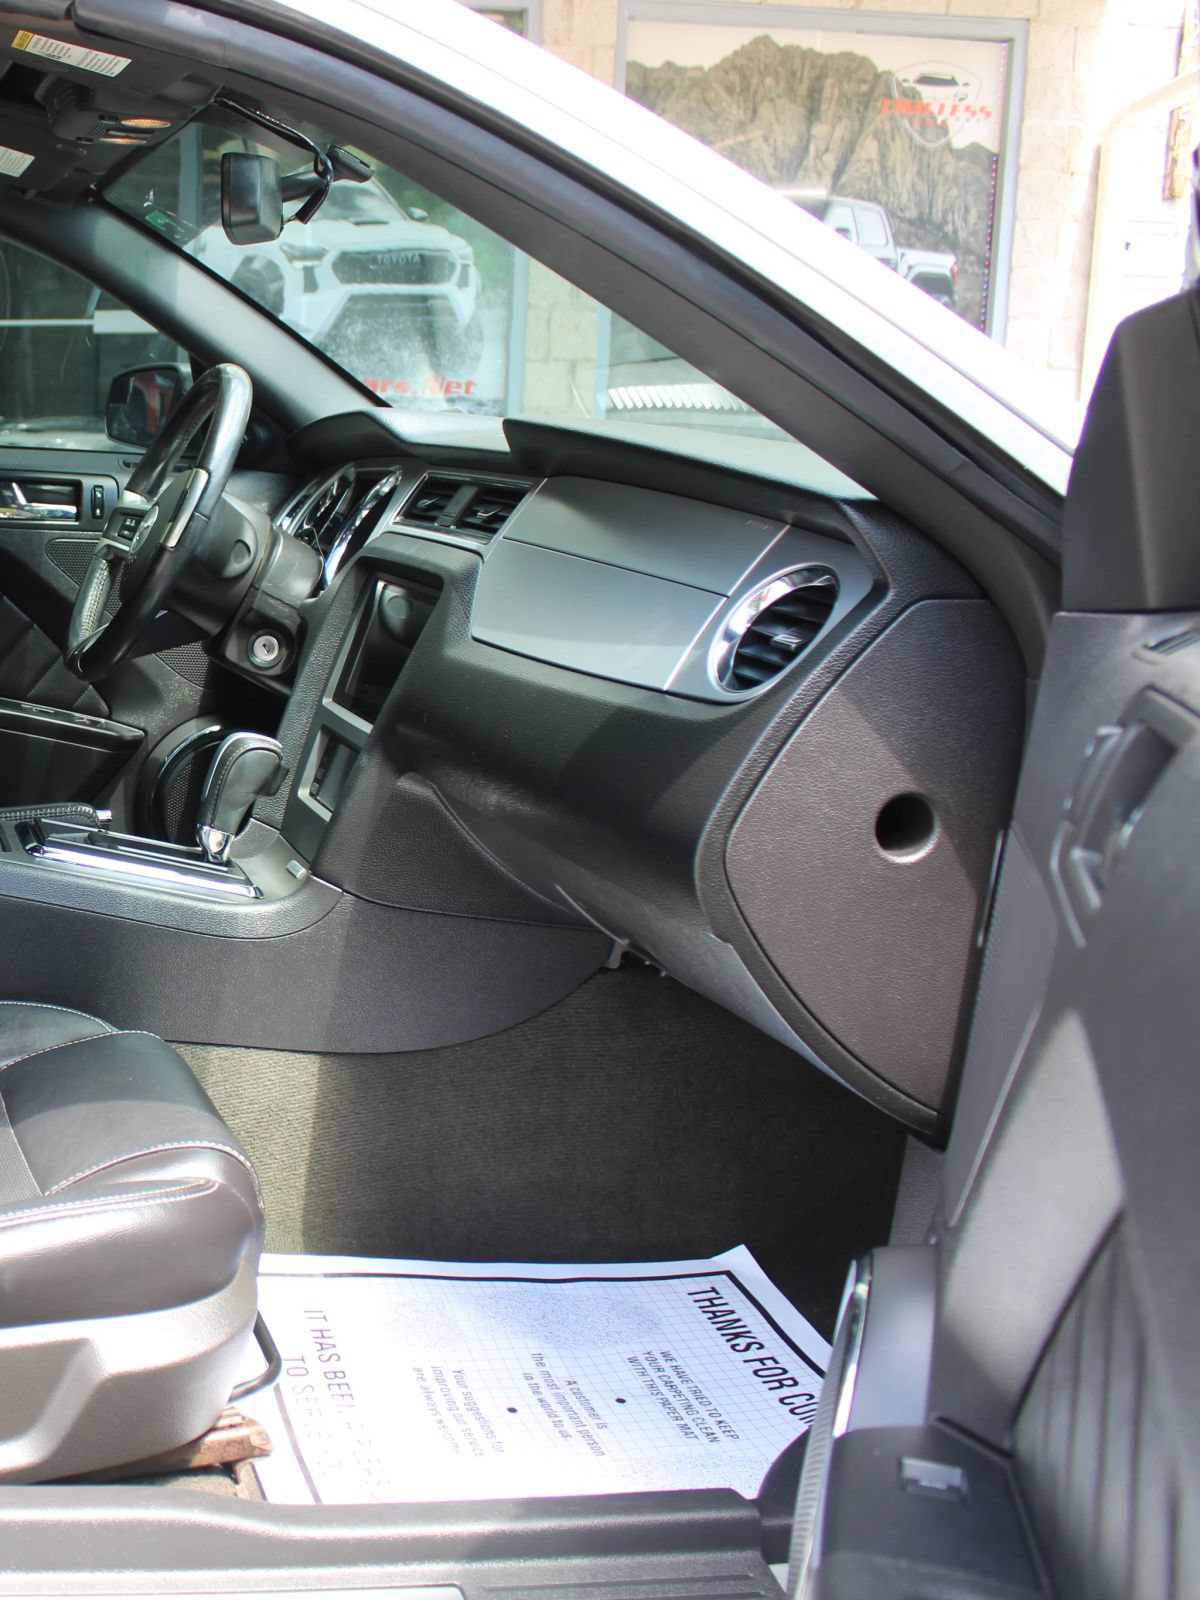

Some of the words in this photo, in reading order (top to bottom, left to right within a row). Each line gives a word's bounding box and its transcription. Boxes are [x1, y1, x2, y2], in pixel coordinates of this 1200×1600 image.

[880, 97, 993, 119] TIMELESS
[377, 252, 421, 264] TOYOTA
[304, 1310, 328, 1322] IT
[687, 1286, 765, 1353] THANKS
[743, 1356, 799, 1391] FOR
[283, 1355, 310, 1377] TO
[310, 1329, 342, 1363] HAS
[420, 1385, 442, 1416] always
[431, 1366, 459, 1412] improving
[452, 1369, 469, 1389] Your
[462, 1391, 497, 1439] suggestions
[490, 1441, 505, 1453] for
[528, 1383, 543, 1396] the
[537, 1398, 559, 1418] world
[552, 1420, 565, 1428] to
[531, 1353, 546, 1368] the
[539, 1371, 560, 1390] most
[552, 1392, 587, 1427] important
[576, 1429, 606, 1456] person
[570, 1388, 601, 1420] customer
[627, 1356, 649, 1377] WITH
[643, 1379, 664, 1397] THIS
[660, 1397, 684, 1421] PAPER
[676, 1423, 699, 1440] MAT
[642, 1351, 666, 1373] YOUR
[658, 1374, 699, 1416] CARPETING
[692, 1417, 720, 1442] CLEAN
[660, 1351, 677, 1363] WE
[669, 1364, 694, 1385] HAVE
[688, 1385, 712, 1407] TRIED
[706, 1408, 722, 1418] TO
[715, 1420, 740, 1440] KEEP
